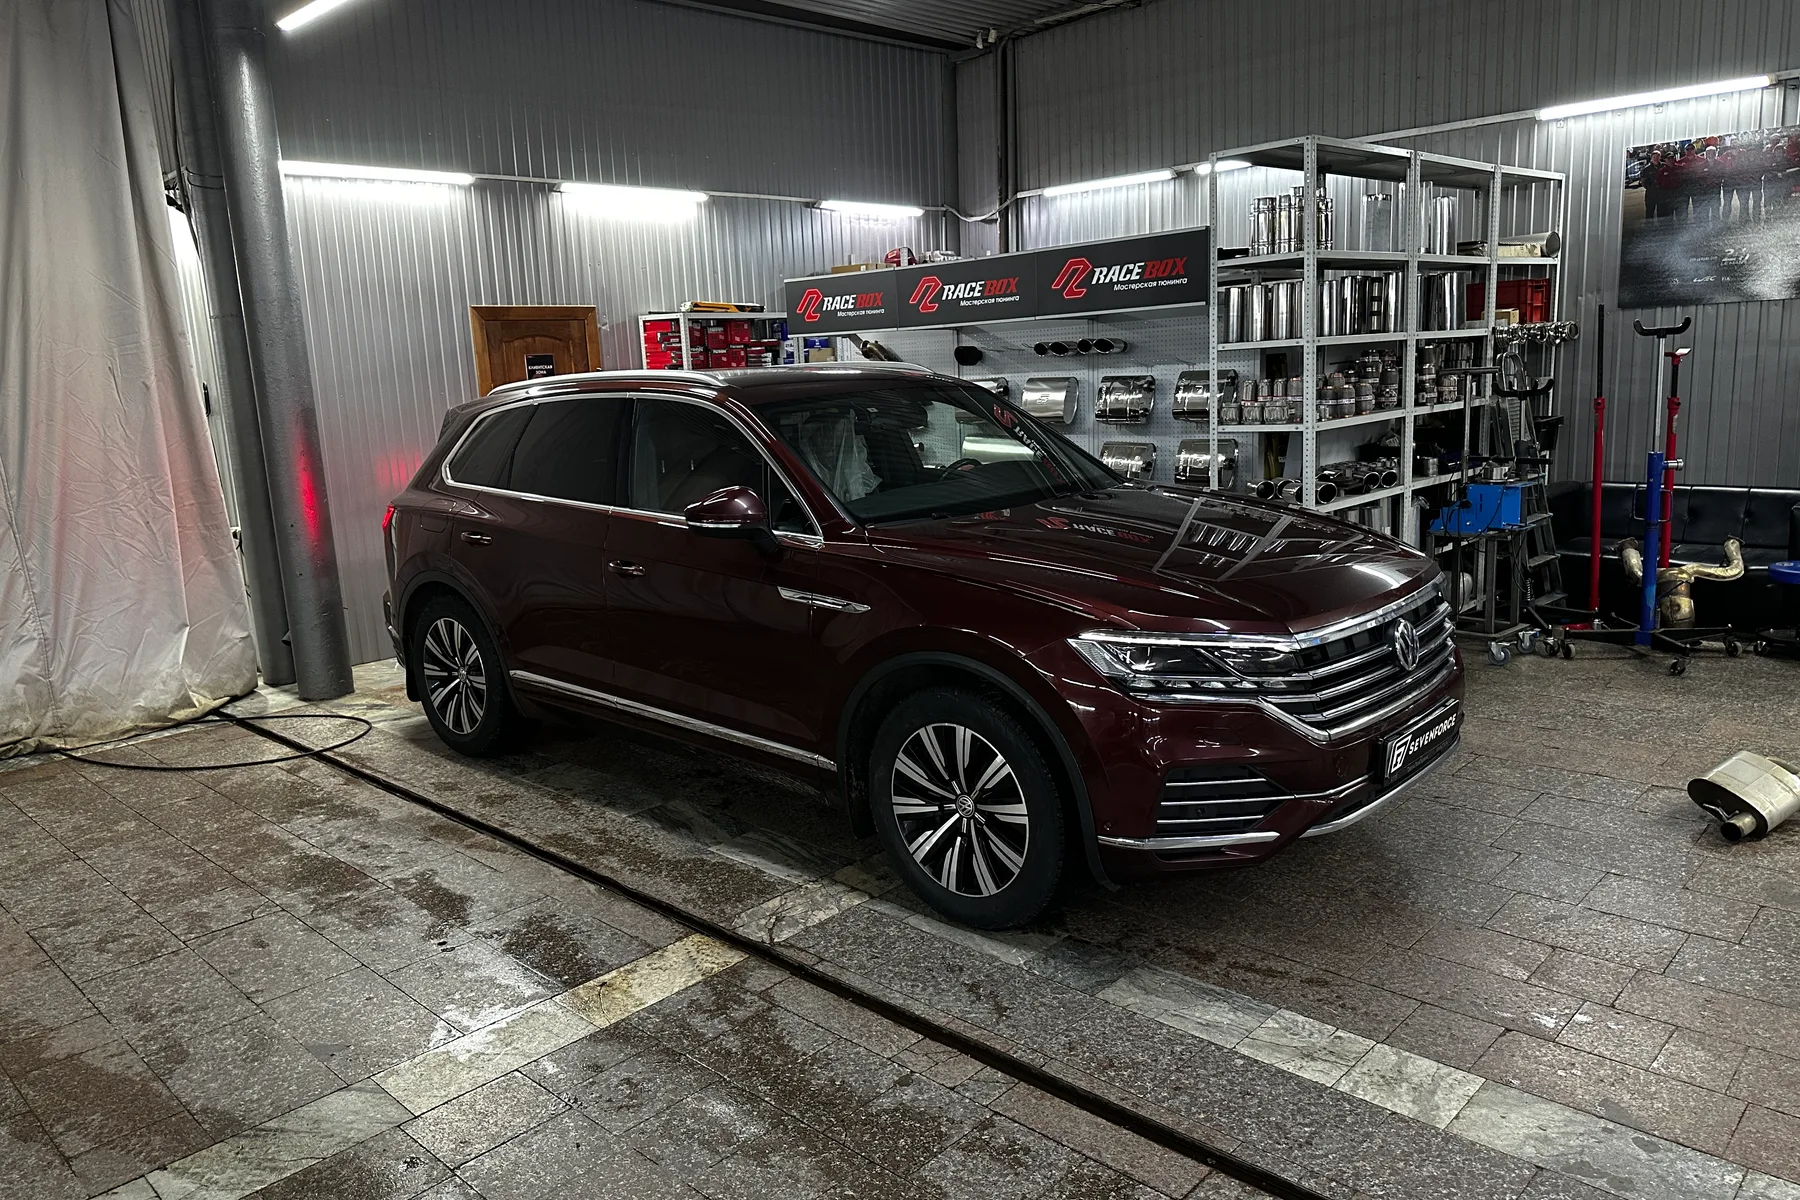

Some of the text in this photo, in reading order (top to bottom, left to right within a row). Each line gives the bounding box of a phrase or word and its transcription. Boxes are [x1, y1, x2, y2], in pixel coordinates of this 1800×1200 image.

[1113, 278, 1188, 291] Мастерская тюнинга
[959, 295, 1020, 307] Мастерская тюнинга
[1408, 713, 1457, 755] SEVENFORCE
